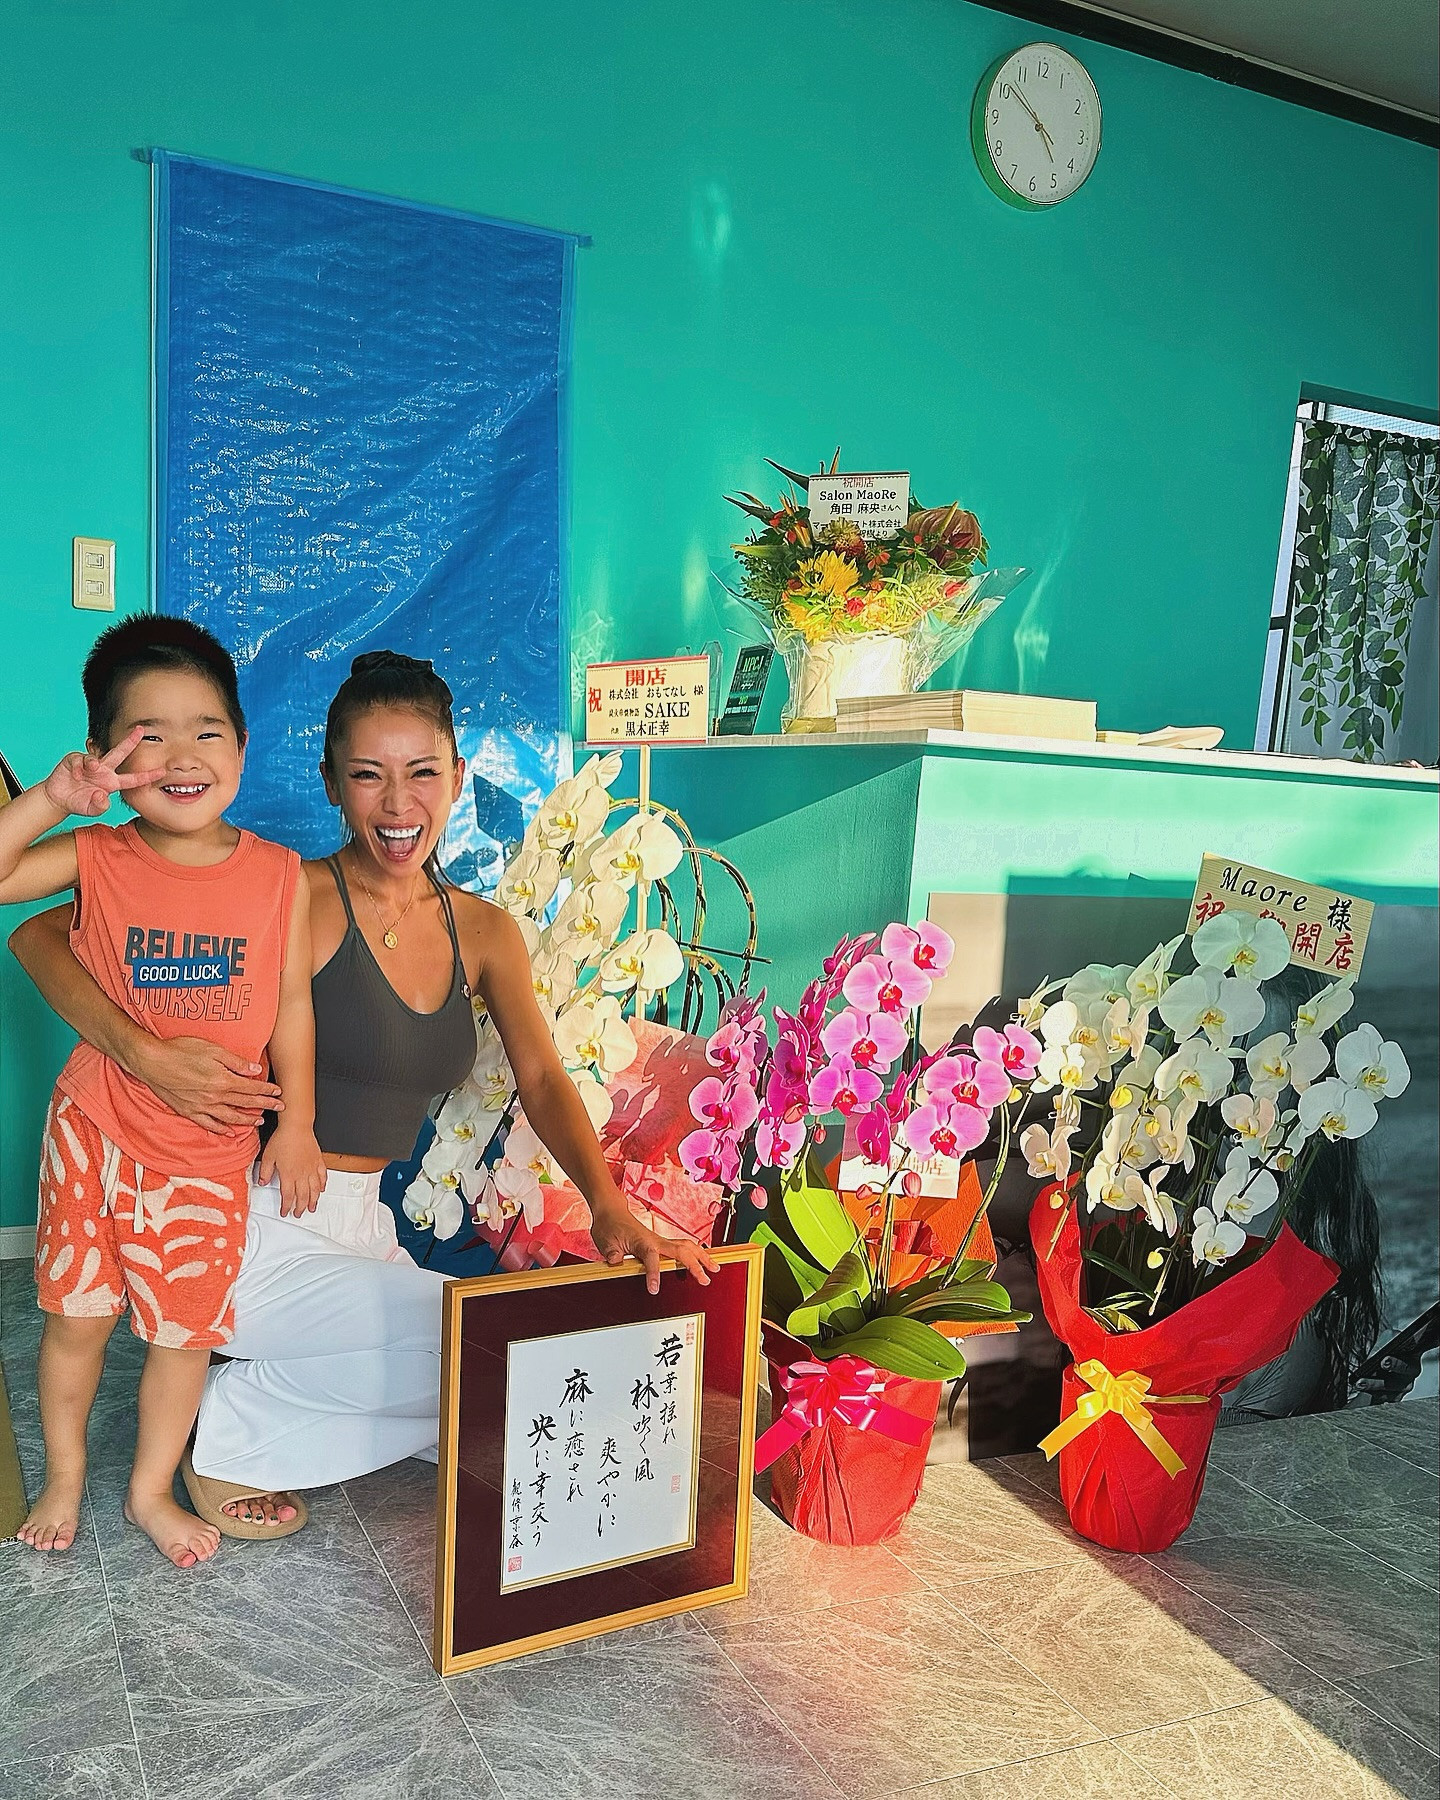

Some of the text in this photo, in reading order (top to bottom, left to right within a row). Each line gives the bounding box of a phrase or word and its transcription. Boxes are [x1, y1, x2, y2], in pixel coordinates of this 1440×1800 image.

[1018, 66, 1027, 83] 11
[1038, 60, 1050, 79] 12
[1060, 73, 1064, 89] 1
[999, 82, 1011, 100] 10
[1074, 99, 1081, 115] 2
[992, 109, 999, 125] 9
[1078, 130, 1084, 146] 3
[995, 140, 1002, 156] 8
[1011, 164, 1018, 180] 7
[1067, 158, 1074, 174] 4
[1029, 176, 1036, 192] 6
[1050, 173, 1057, 188] 5
[842, 477, 874, 488] 祝開店
[820, 490, 897, 500] Salon MaoRe
[830, 503, 902, 515] 角田 麻央さんへ
[625, 668, 667, 687] 開店
[588, 686, 602, 713] 祝
[608, 684, 704, 700] 株式会社 おもてなし 様
[644, 701, 690, 719] SAKE
[625, 720, 670, 736] 黒木正幸
[1219, 866, 1353, 933] Maore 様
[124, 926, 247, 976] BELIEVE
[139, 966, 179, 981] GOOD
[654, 1333, 683, 1444] 若葉揺れ
[559, 1368, 594, 1502] 麻に癒され
[630, 1374, 660, 1482] 林吹く風
[527, 1414, 558, 1548] 央に幸交う
[597, 1437, 622, 1537] 爽やかに
